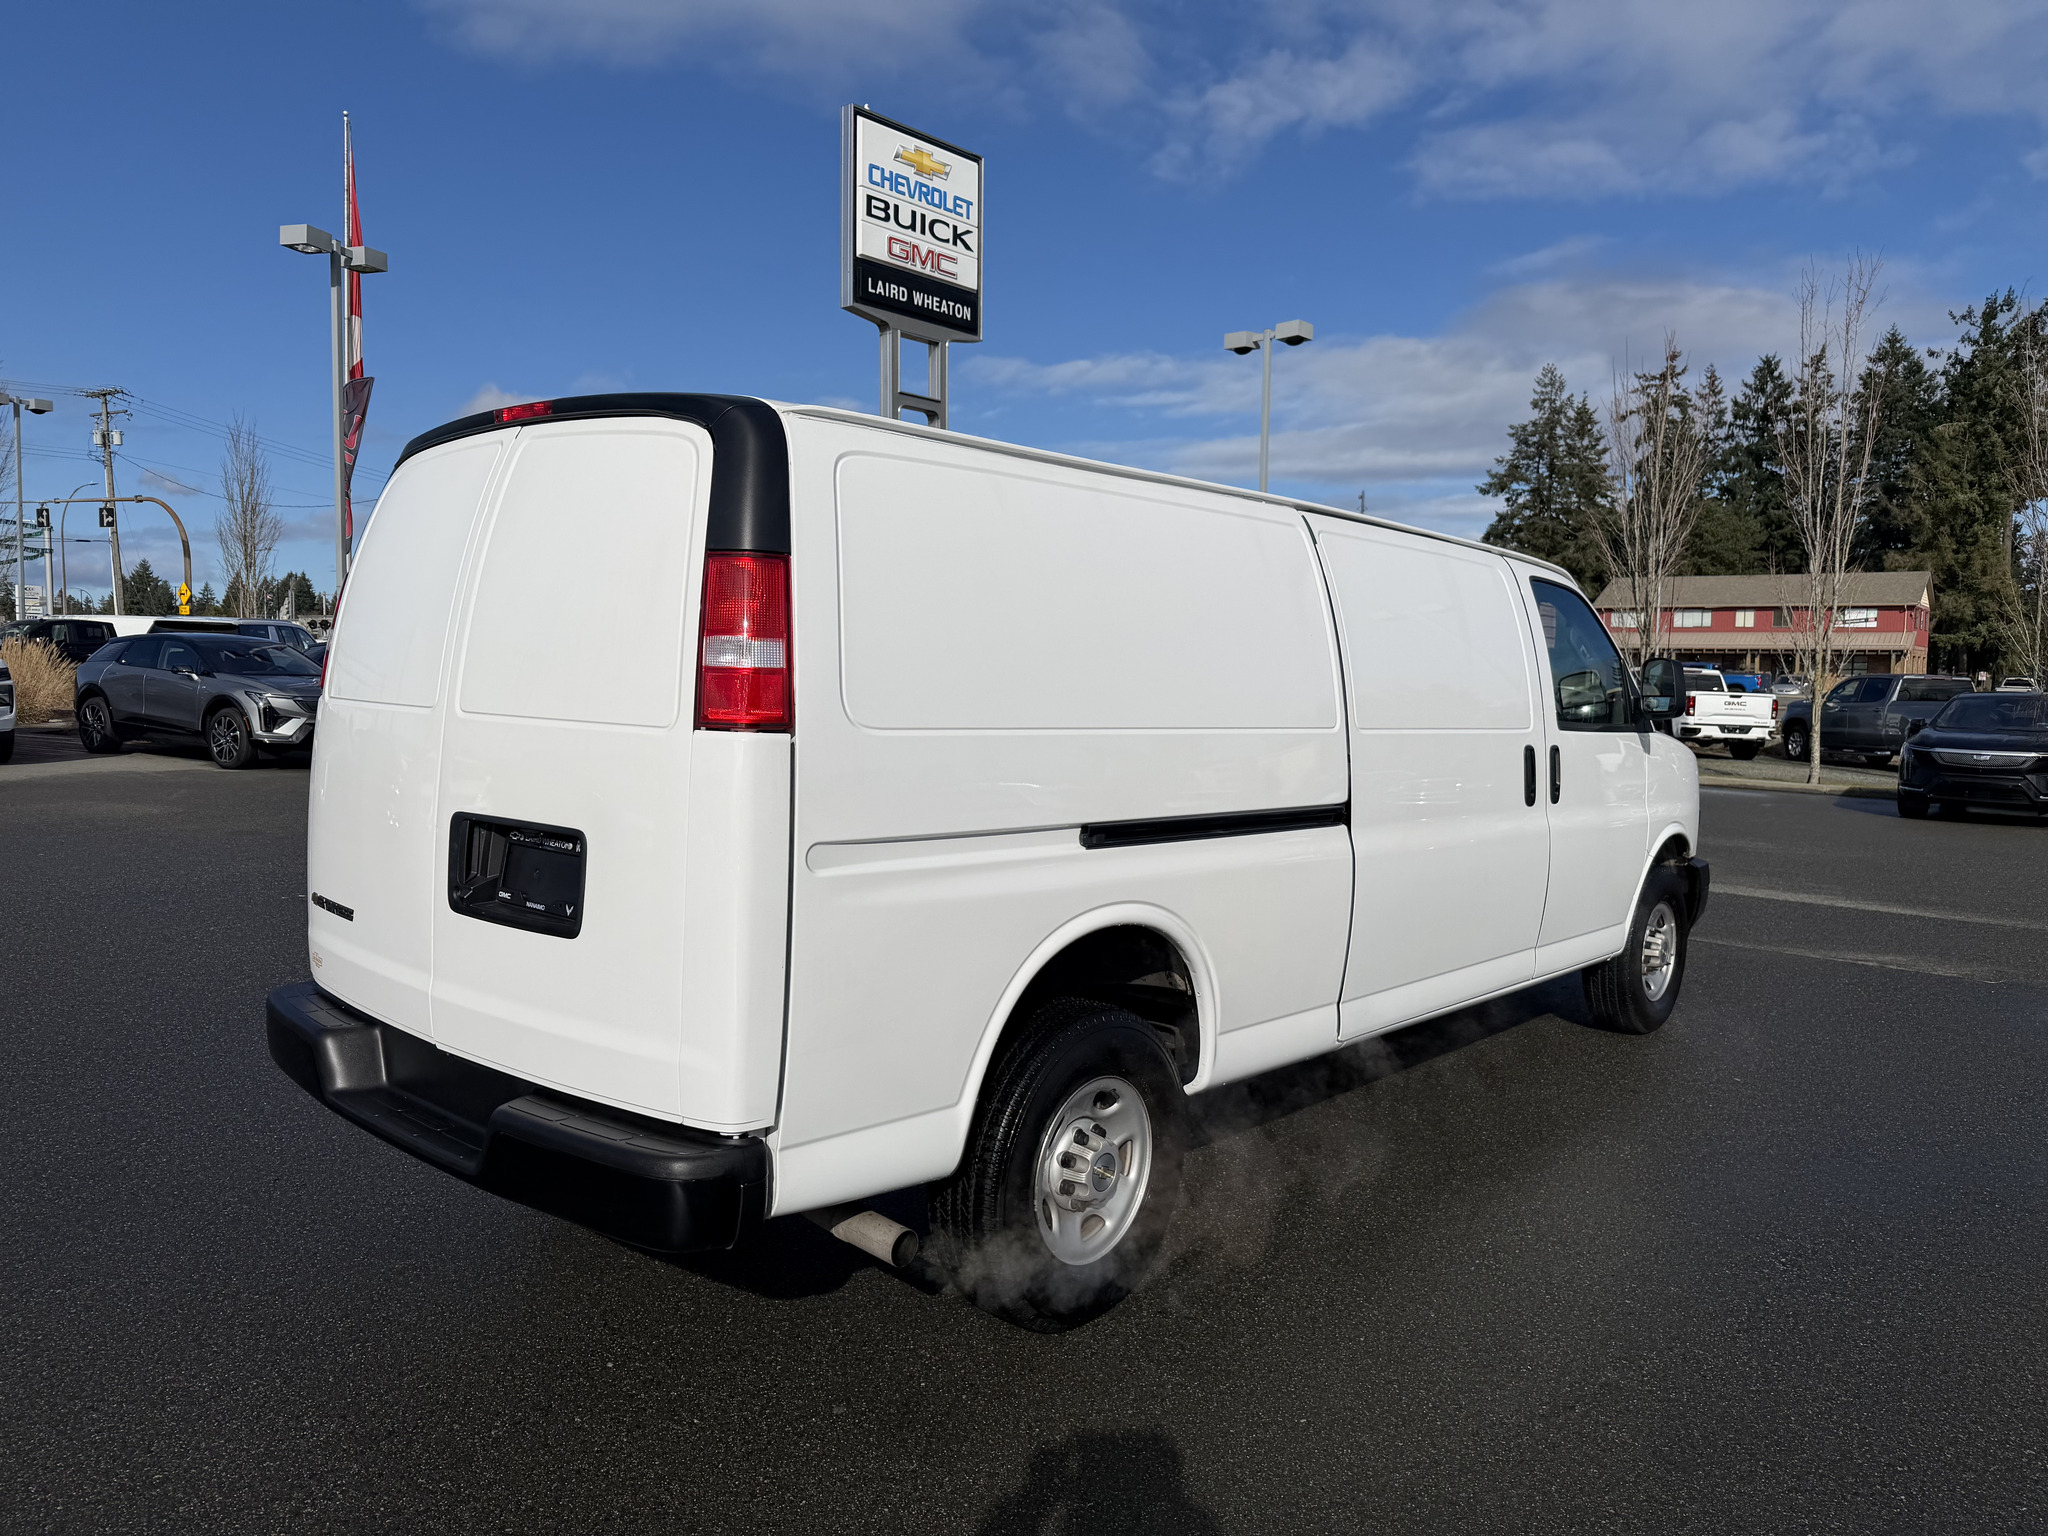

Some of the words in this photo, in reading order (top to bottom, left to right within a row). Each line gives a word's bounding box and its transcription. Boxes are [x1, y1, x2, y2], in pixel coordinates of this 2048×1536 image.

[868, 163, 973, 220] CHEVROLET
[866, 193, 974, 253] BUICK
[887, 234, 958, 280] GMC
[868, 277, 908, 302] LAIRD
[913, 290, 971, 321] WHEATON
[498, 891, 512, 900] GMC
